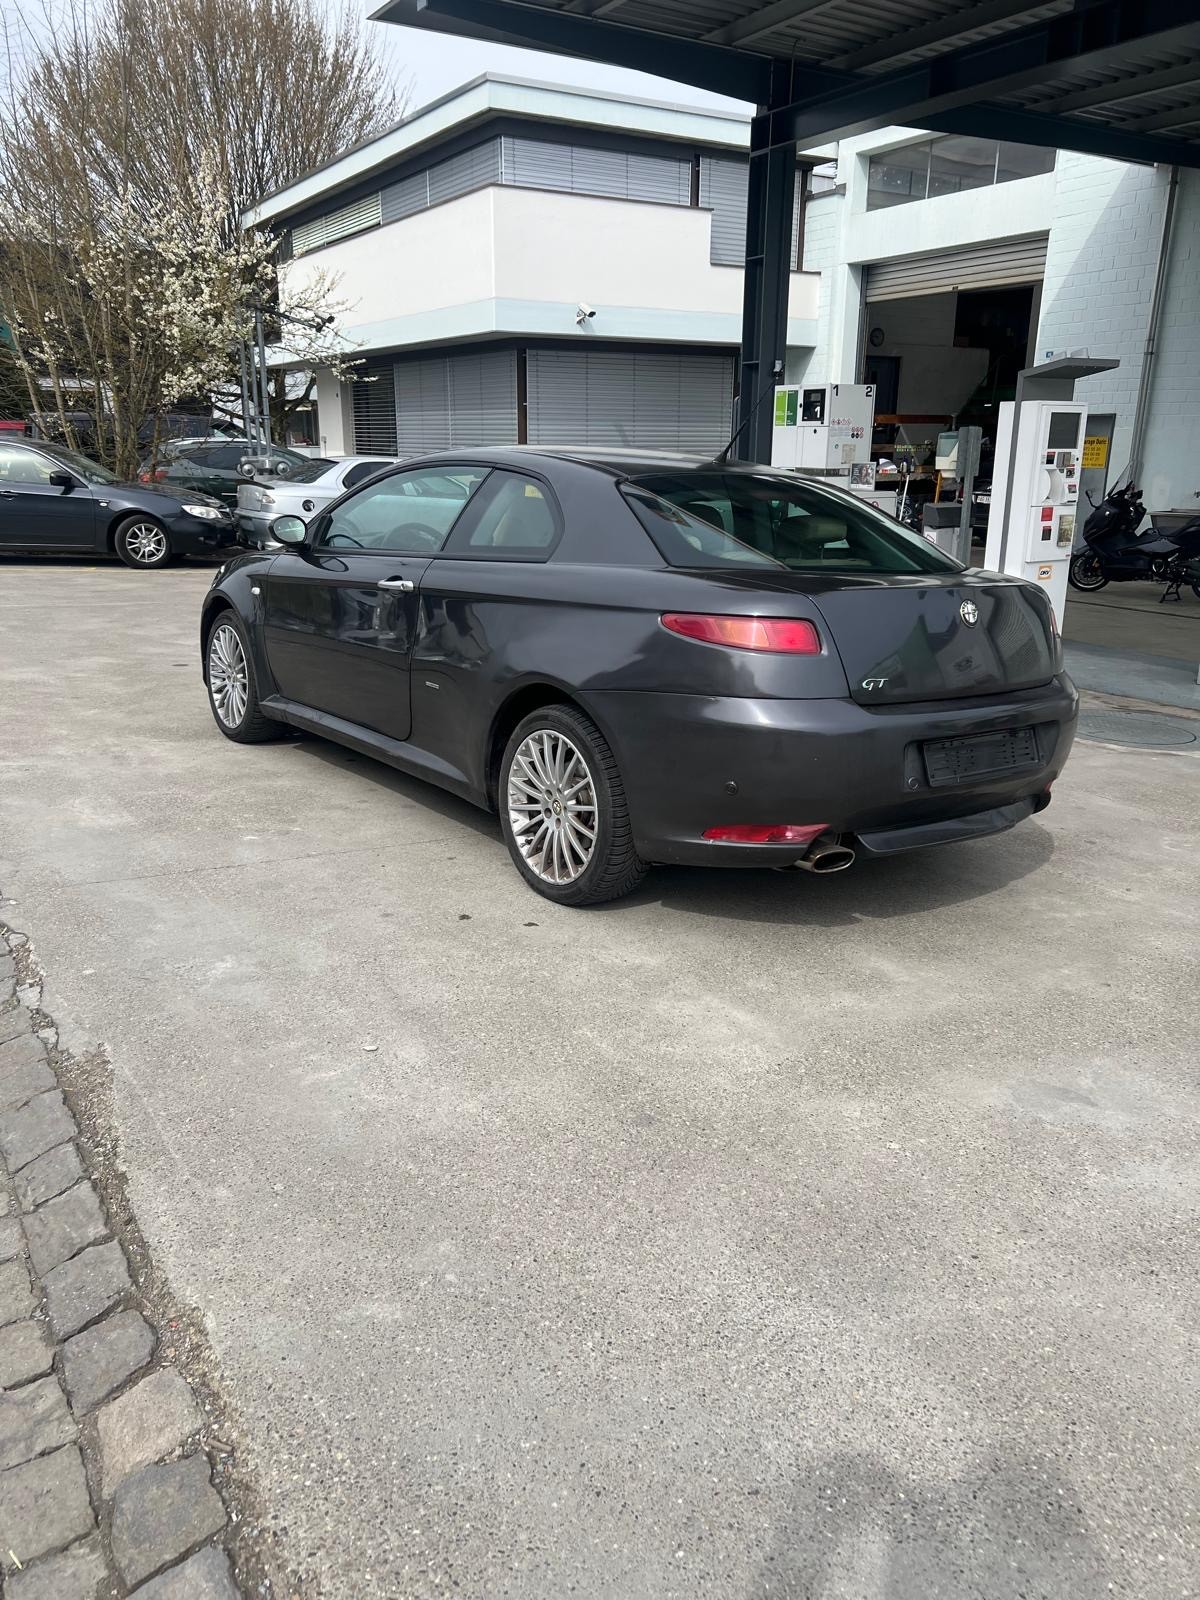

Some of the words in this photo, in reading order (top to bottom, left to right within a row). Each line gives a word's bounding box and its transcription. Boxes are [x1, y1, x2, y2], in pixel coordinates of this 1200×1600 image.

[833, 385, 839, 396] 1
[865, 386, 873, 397] 2
[815, 406, 820, 418] 1
[862, 678, 888, 690] GT
